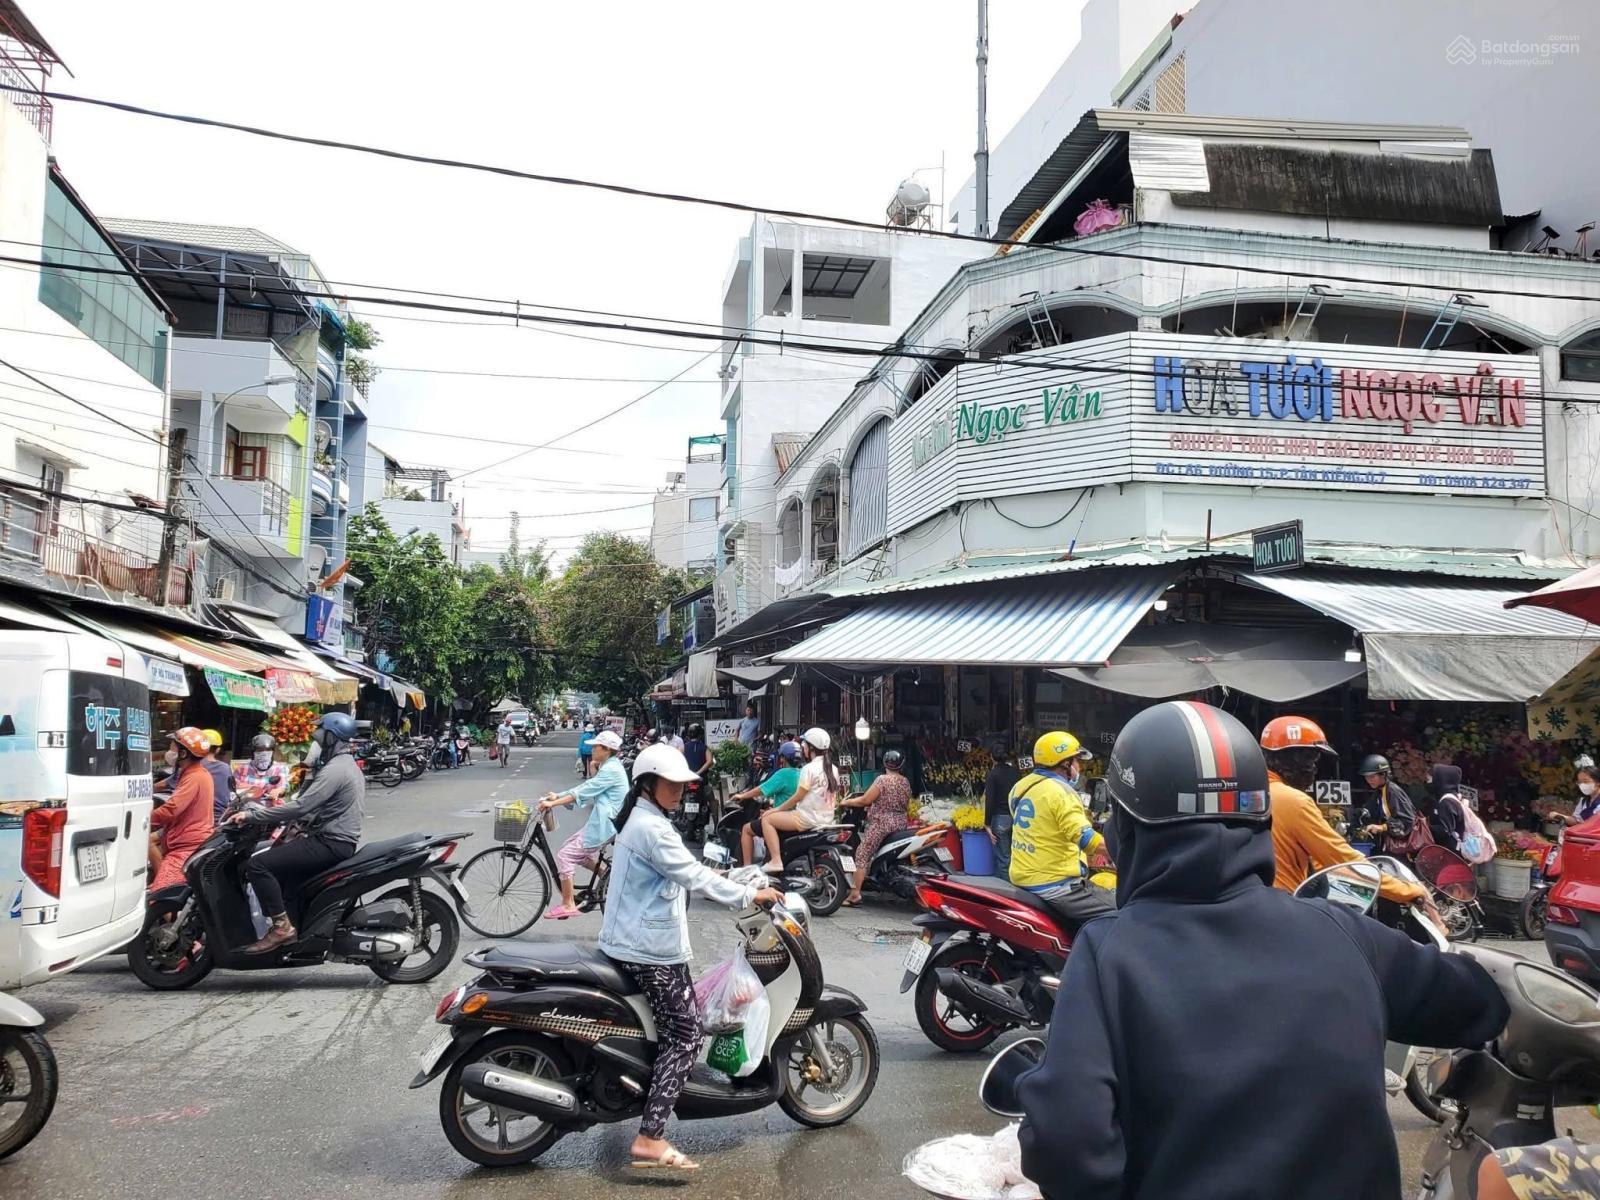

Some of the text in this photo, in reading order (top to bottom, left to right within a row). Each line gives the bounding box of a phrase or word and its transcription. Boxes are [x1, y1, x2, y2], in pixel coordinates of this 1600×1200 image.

[957, 383, 1104, 443] Ngọc Vân
[1240, 354, 1333, 421] TƯƠI
[1340, 369, 1447, 434] NGỌC
[1454, 362, 1526, 427] VÂN
[1170, 429, 1234, 453] CHUYÊN
[1324, 434, 1351, 458] CÁC
[1358, 441, 1394, 465] DỊCH
[1400, 445, 1417, 466] VỤ
[1446, 447, 1475, 464] HOA
[1256, 532, 1297, 566] HOA TƯƠI
